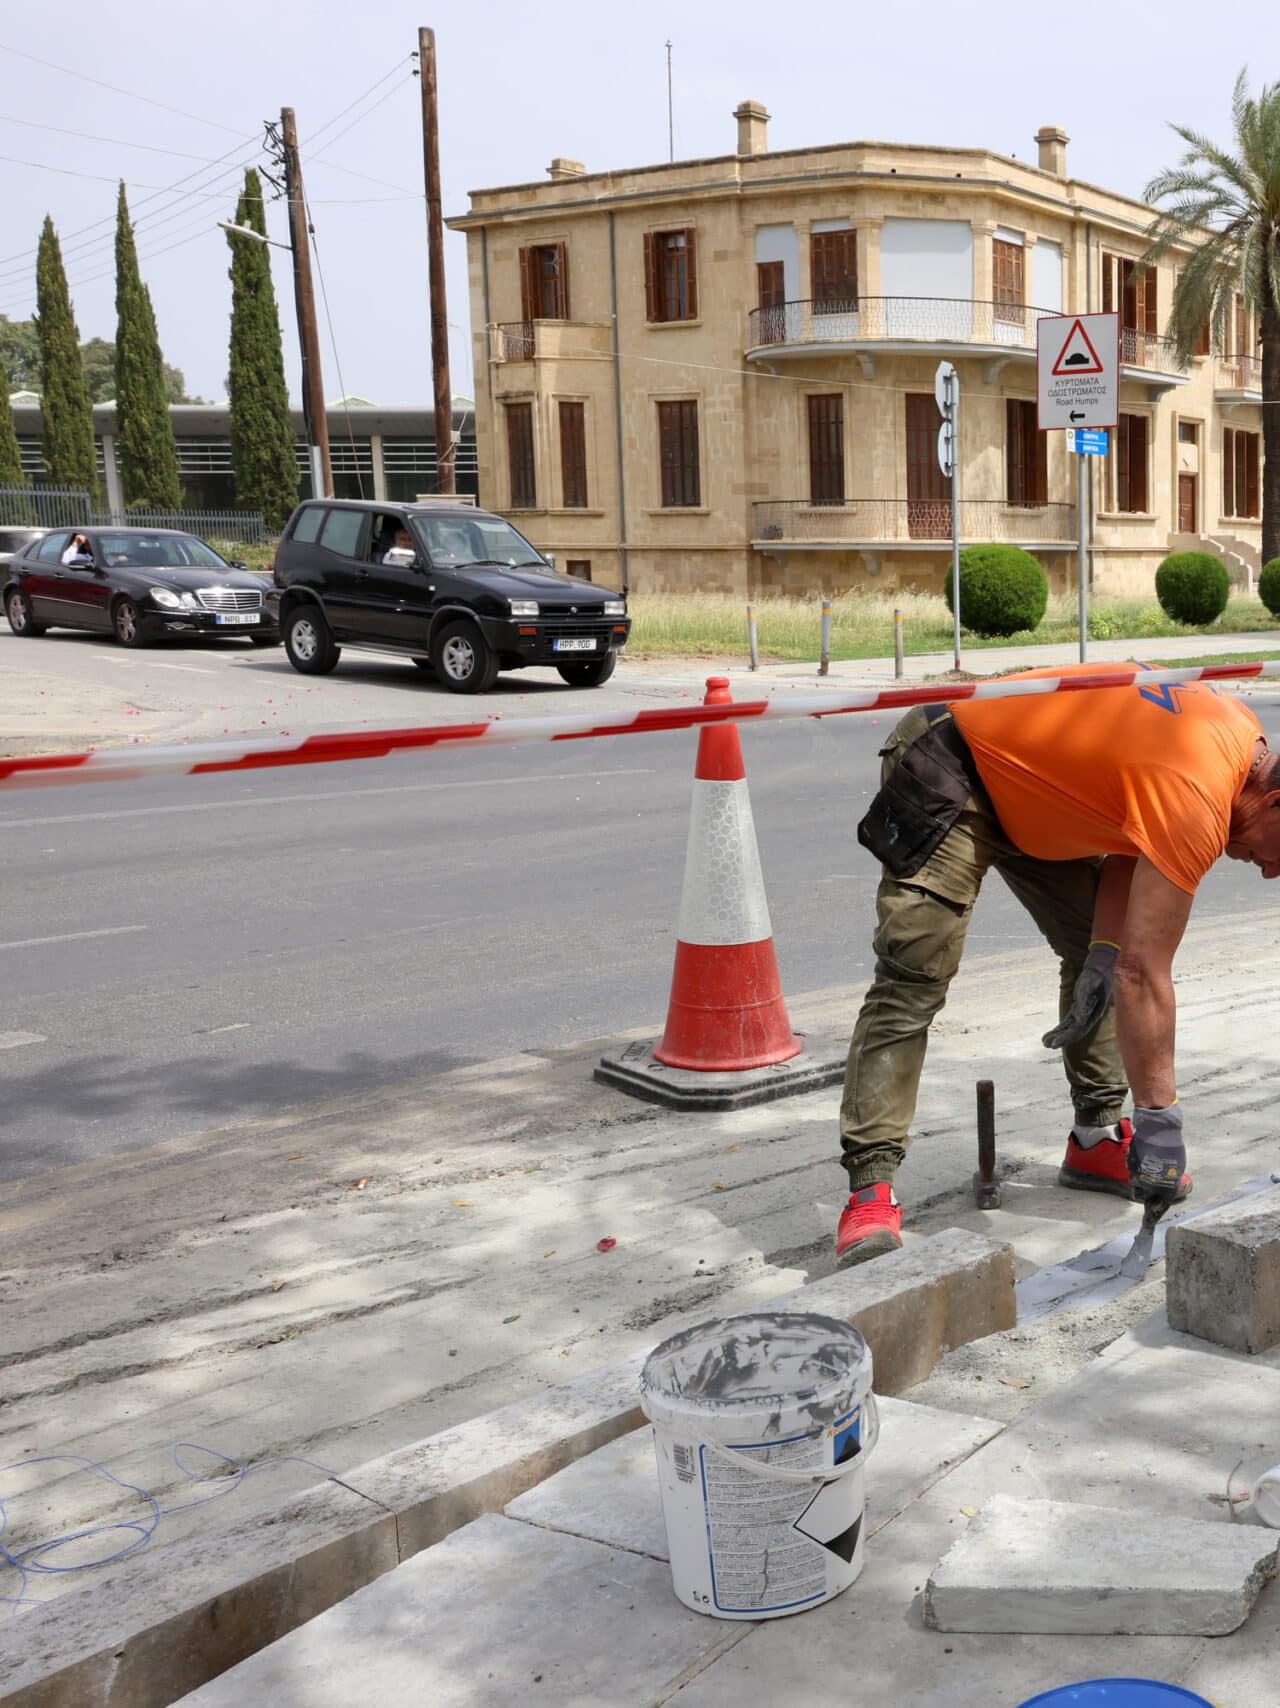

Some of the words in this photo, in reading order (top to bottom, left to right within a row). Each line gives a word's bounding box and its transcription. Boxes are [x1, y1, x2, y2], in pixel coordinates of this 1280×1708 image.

[1055, 377, 1100, 388] ΚΥΡΤΩΜΑΤΑ
[1047, 386, 1107, 398] ΟΔΟΣΤΡΩΜΑΤΟΣ
[1056, 398, 1074, 406] Road
[1075, 397, 1099, 405] Humps
